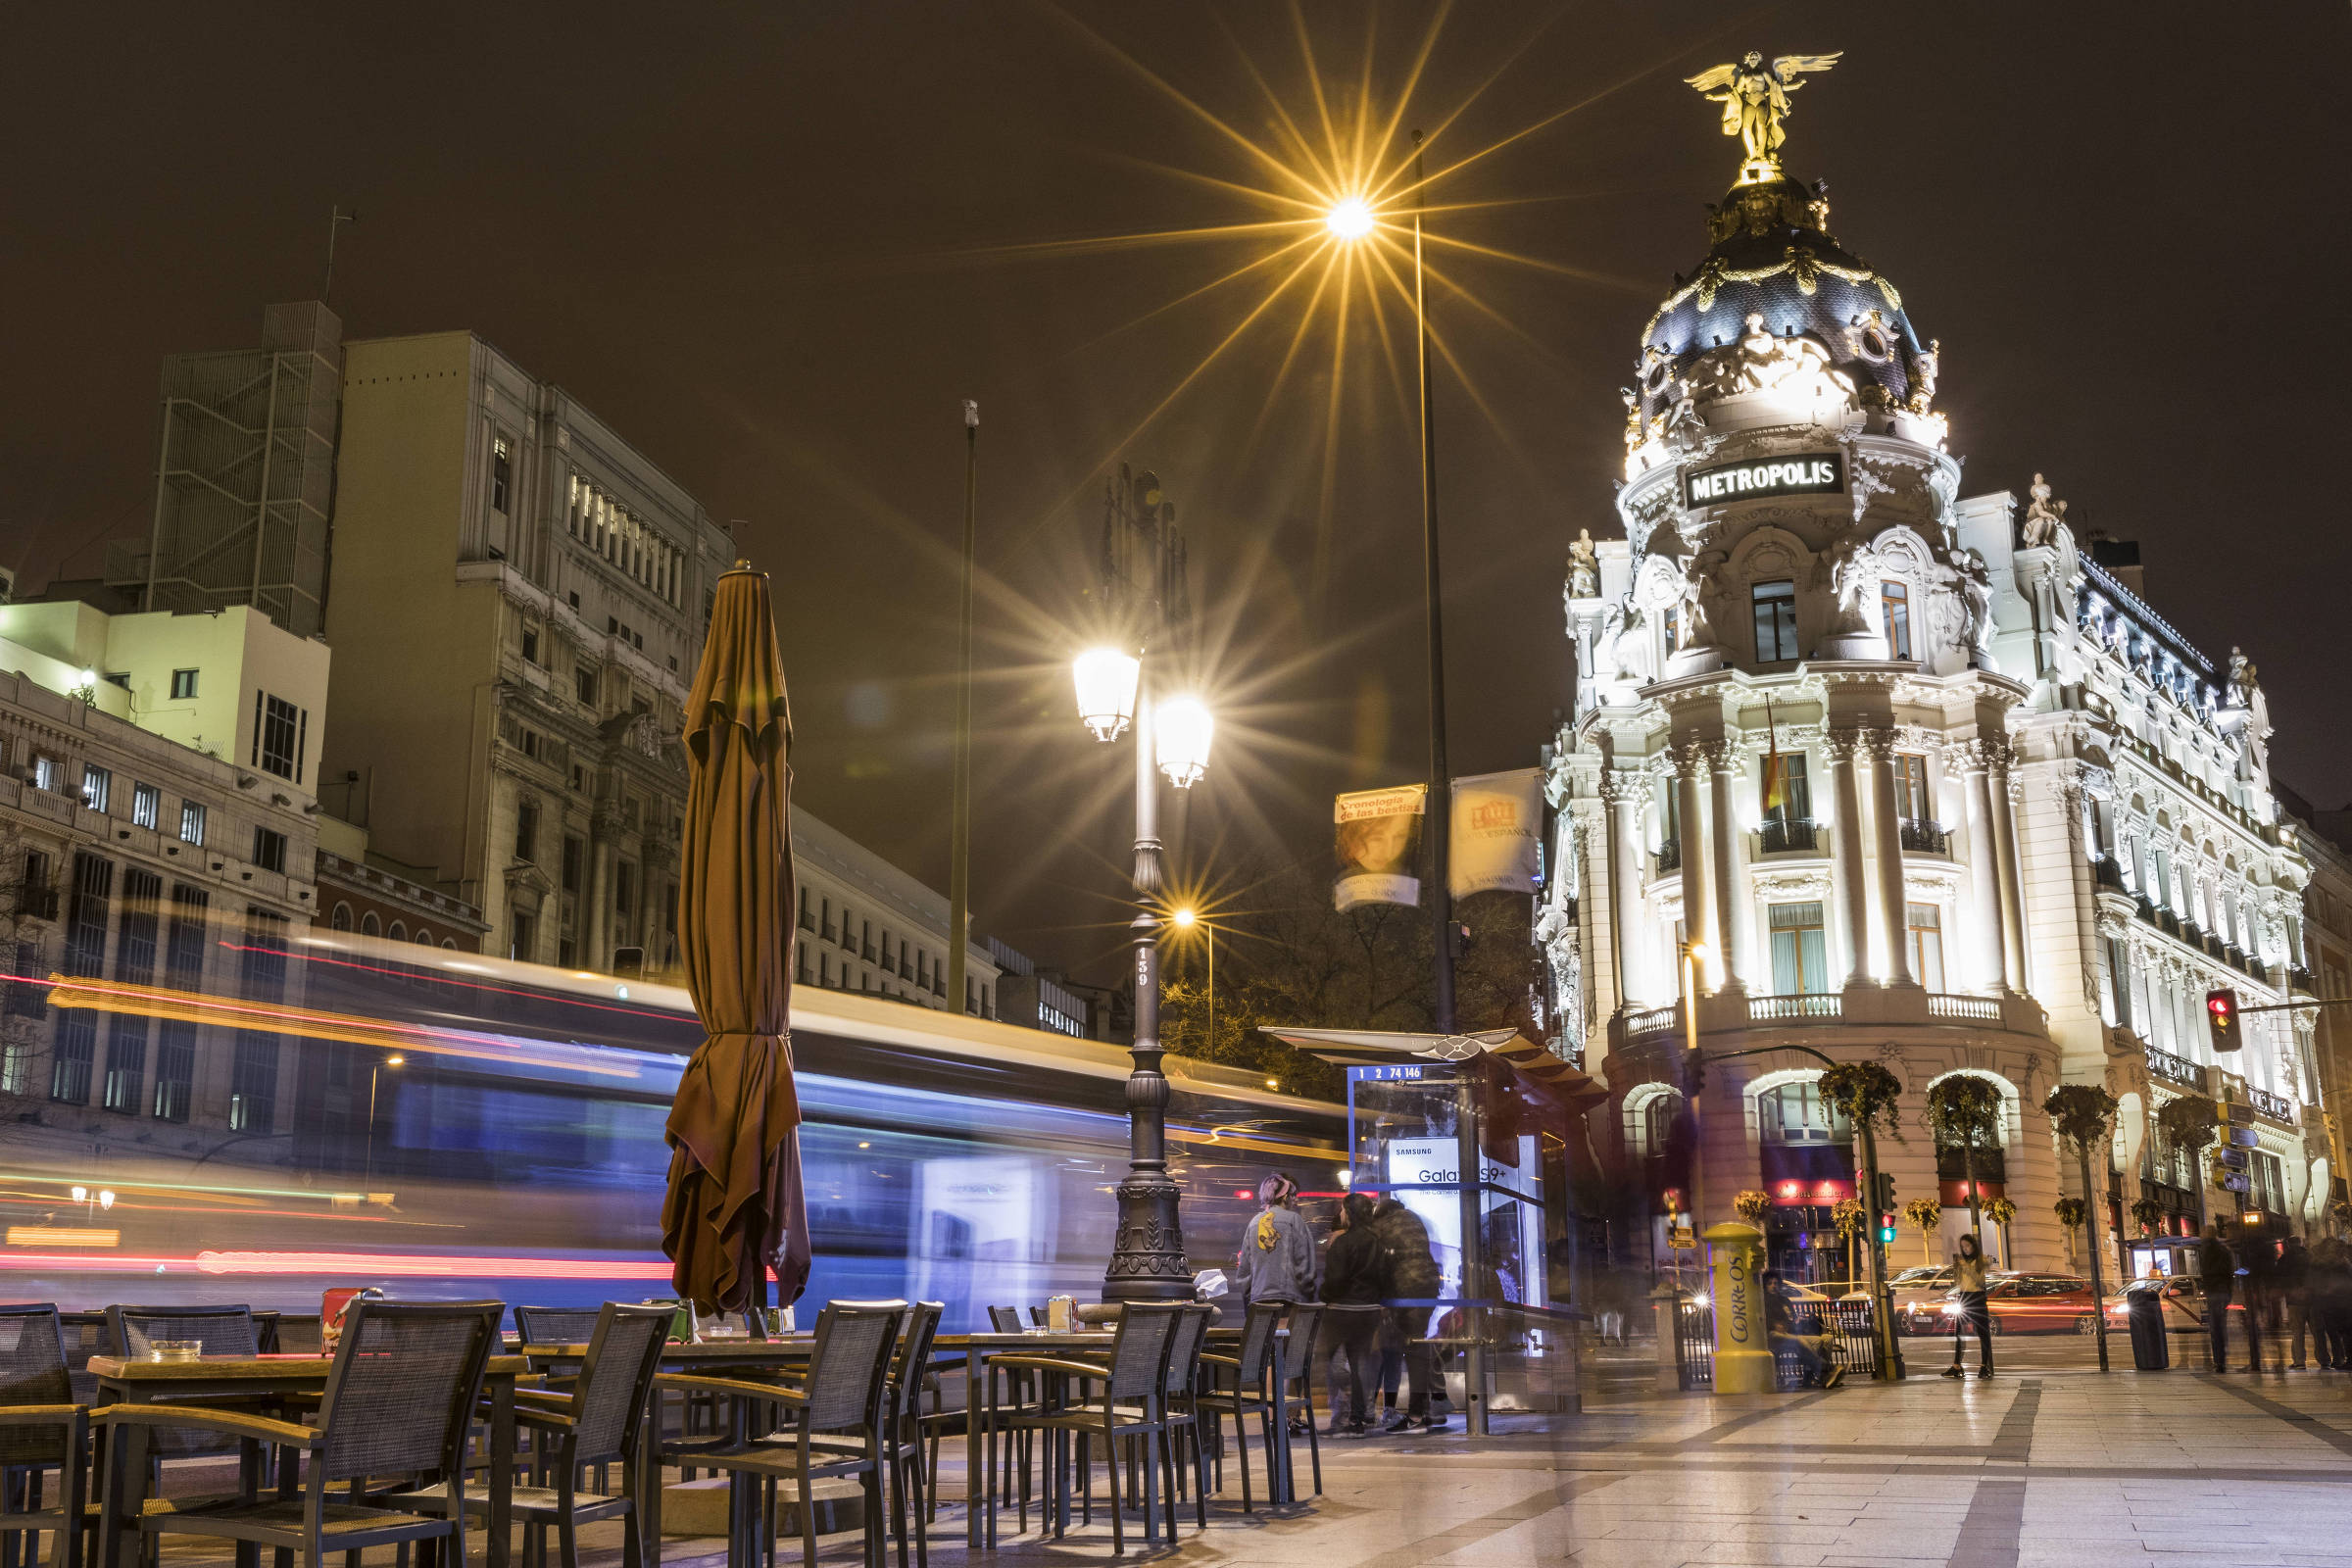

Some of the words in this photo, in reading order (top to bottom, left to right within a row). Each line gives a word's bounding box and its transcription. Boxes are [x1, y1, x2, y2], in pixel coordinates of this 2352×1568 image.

[1691, 462, 1835, 501] METROPOLIS
[1341, 796, 1403, 810] Cronología
[1340, 811, 1353, 821] de
[1356, 808, 1373, 817] las
[1377, 804, 1420, 815] bestias
[1139, 947, 1148, 986] 159
[1359, 1068, 1364, 1079] 1
[1375, 1068, 1382, 1079] 2
[1390, 1067, 1401, 1078] 74
[1404, 1067, 1420, 1078] 146
[1418, 1169, 1460, 1183] Gala
[1480, 1167, 1506, 1181] S9+
[1728, 1255, 1749, 1344] CORREOS
